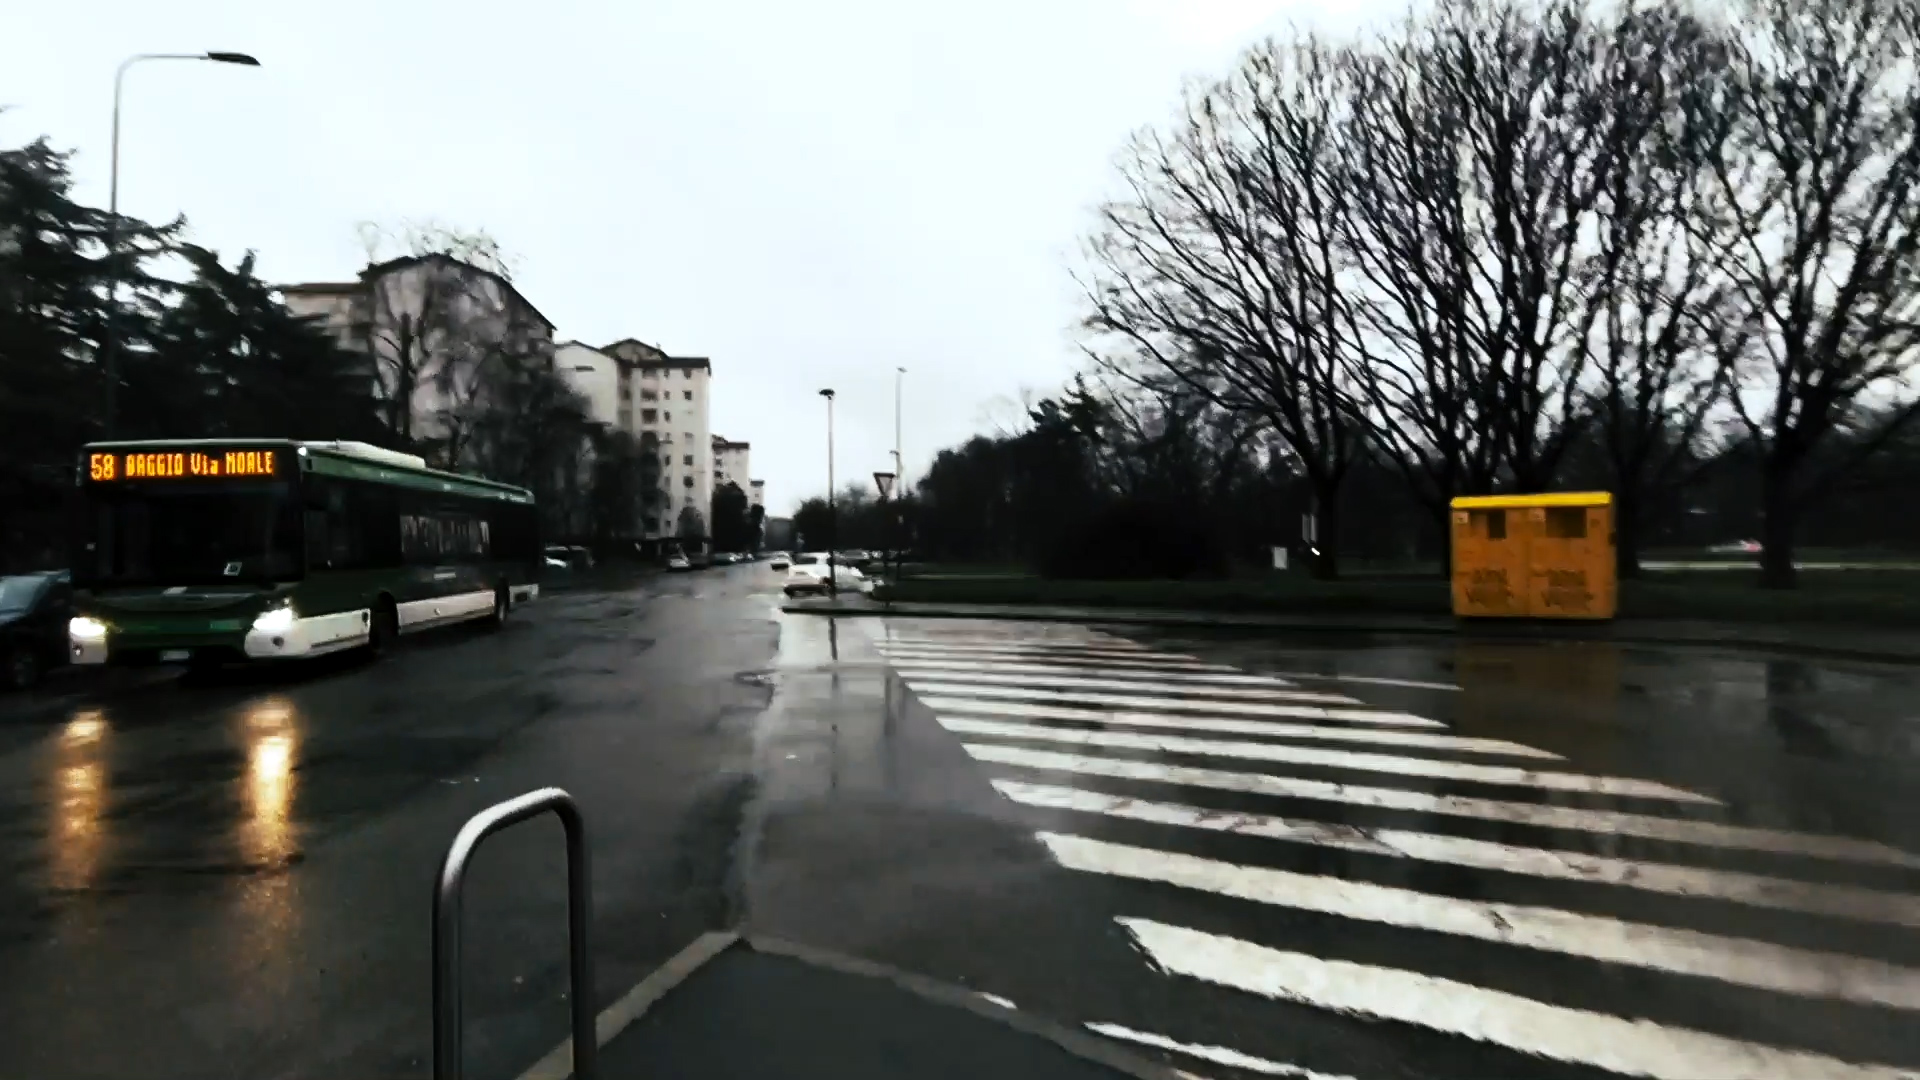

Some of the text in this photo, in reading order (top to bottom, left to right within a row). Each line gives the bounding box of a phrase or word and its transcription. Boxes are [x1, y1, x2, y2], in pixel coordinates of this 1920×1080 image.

[90, 454, 115, 480] 58
[126, 453, 184, 476] BAGGIO
[190, 453, 219, 475] Via
